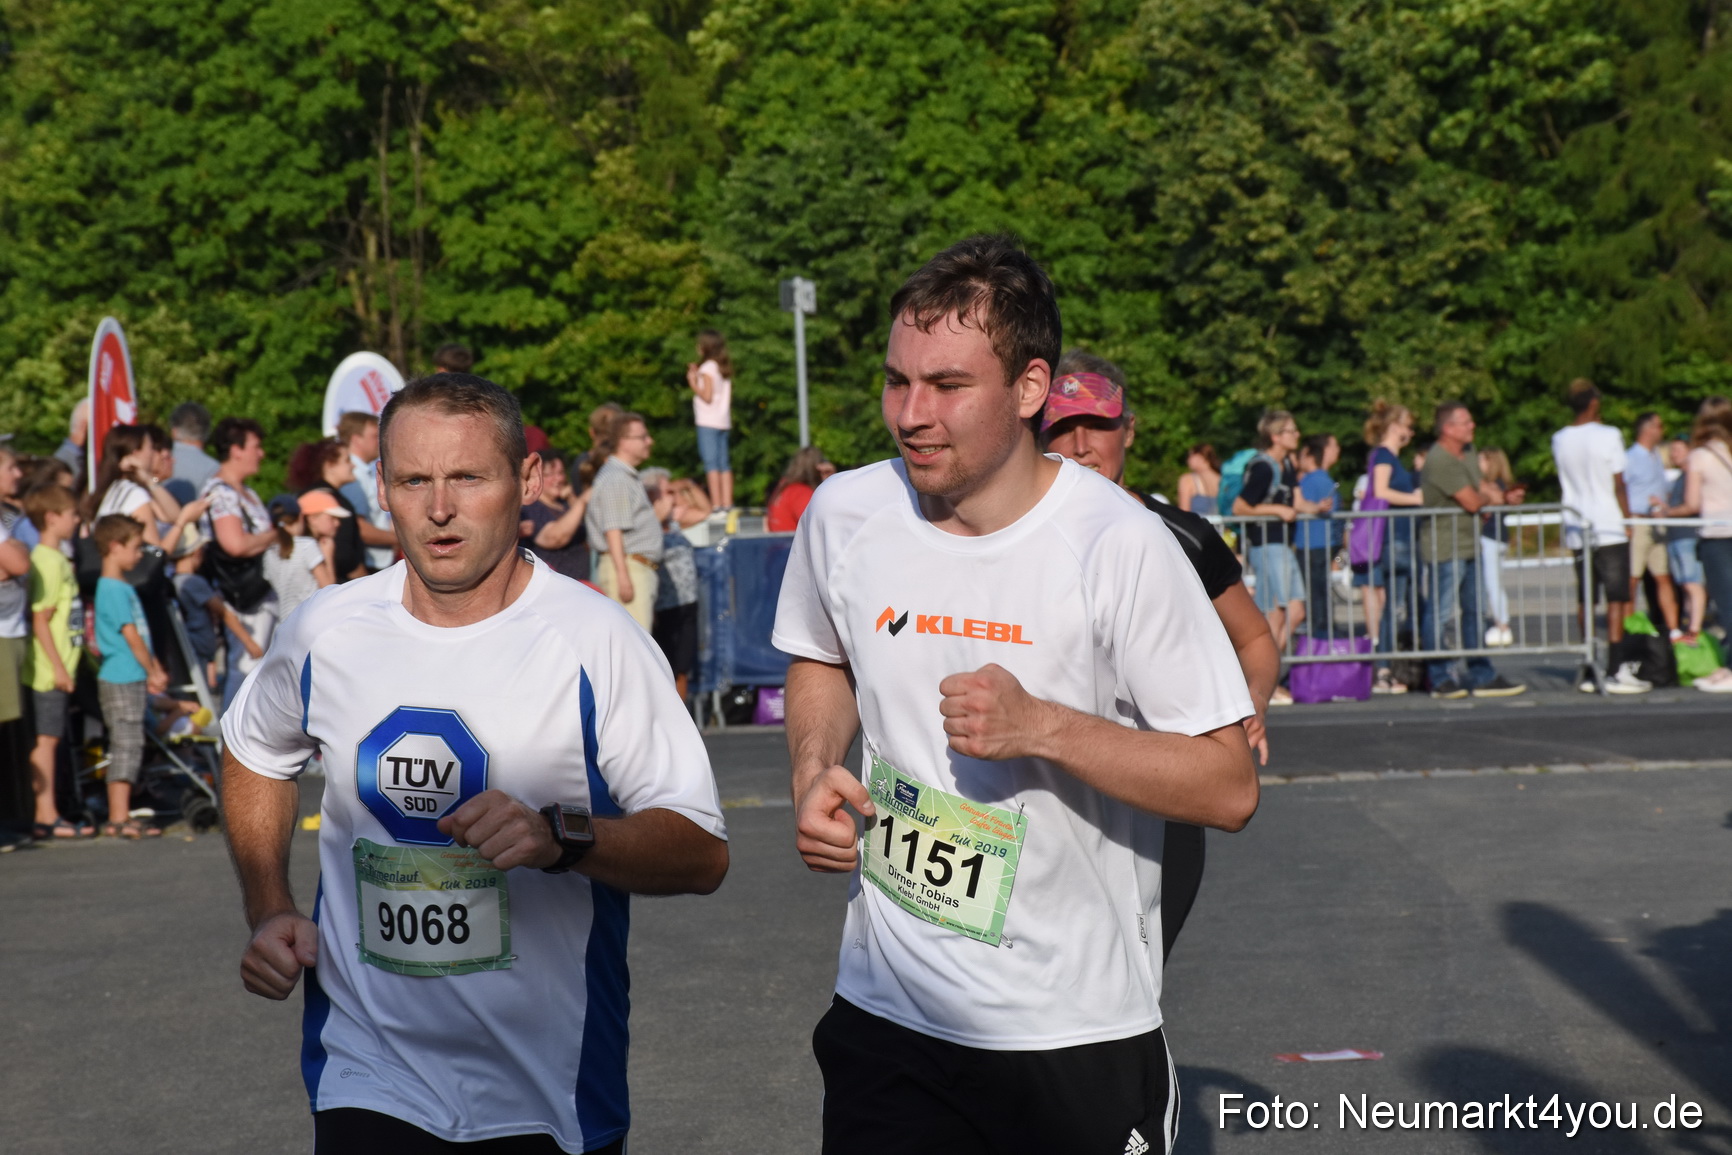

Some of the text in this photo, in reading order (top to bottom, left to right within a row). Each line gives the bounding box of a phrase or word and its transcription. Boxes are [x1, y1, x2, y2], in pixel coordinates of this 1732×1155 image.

[916, 614, 1033, 645] KLEBL
[386, 756, 455, 789] TÜV
[404, 796, 438, 812] SÜD
[880, 815, 984, 899] 1151
[950, 833, 1007, 858] run 2019
[440, 877, 497, 890] run 2019
[888, 864, 917, 890] Dirner
[920, 883, 960, 908] Tobias
[897, 885, 940, 912] Klebl GmbH
[378, 902, 470, 945] 9068
